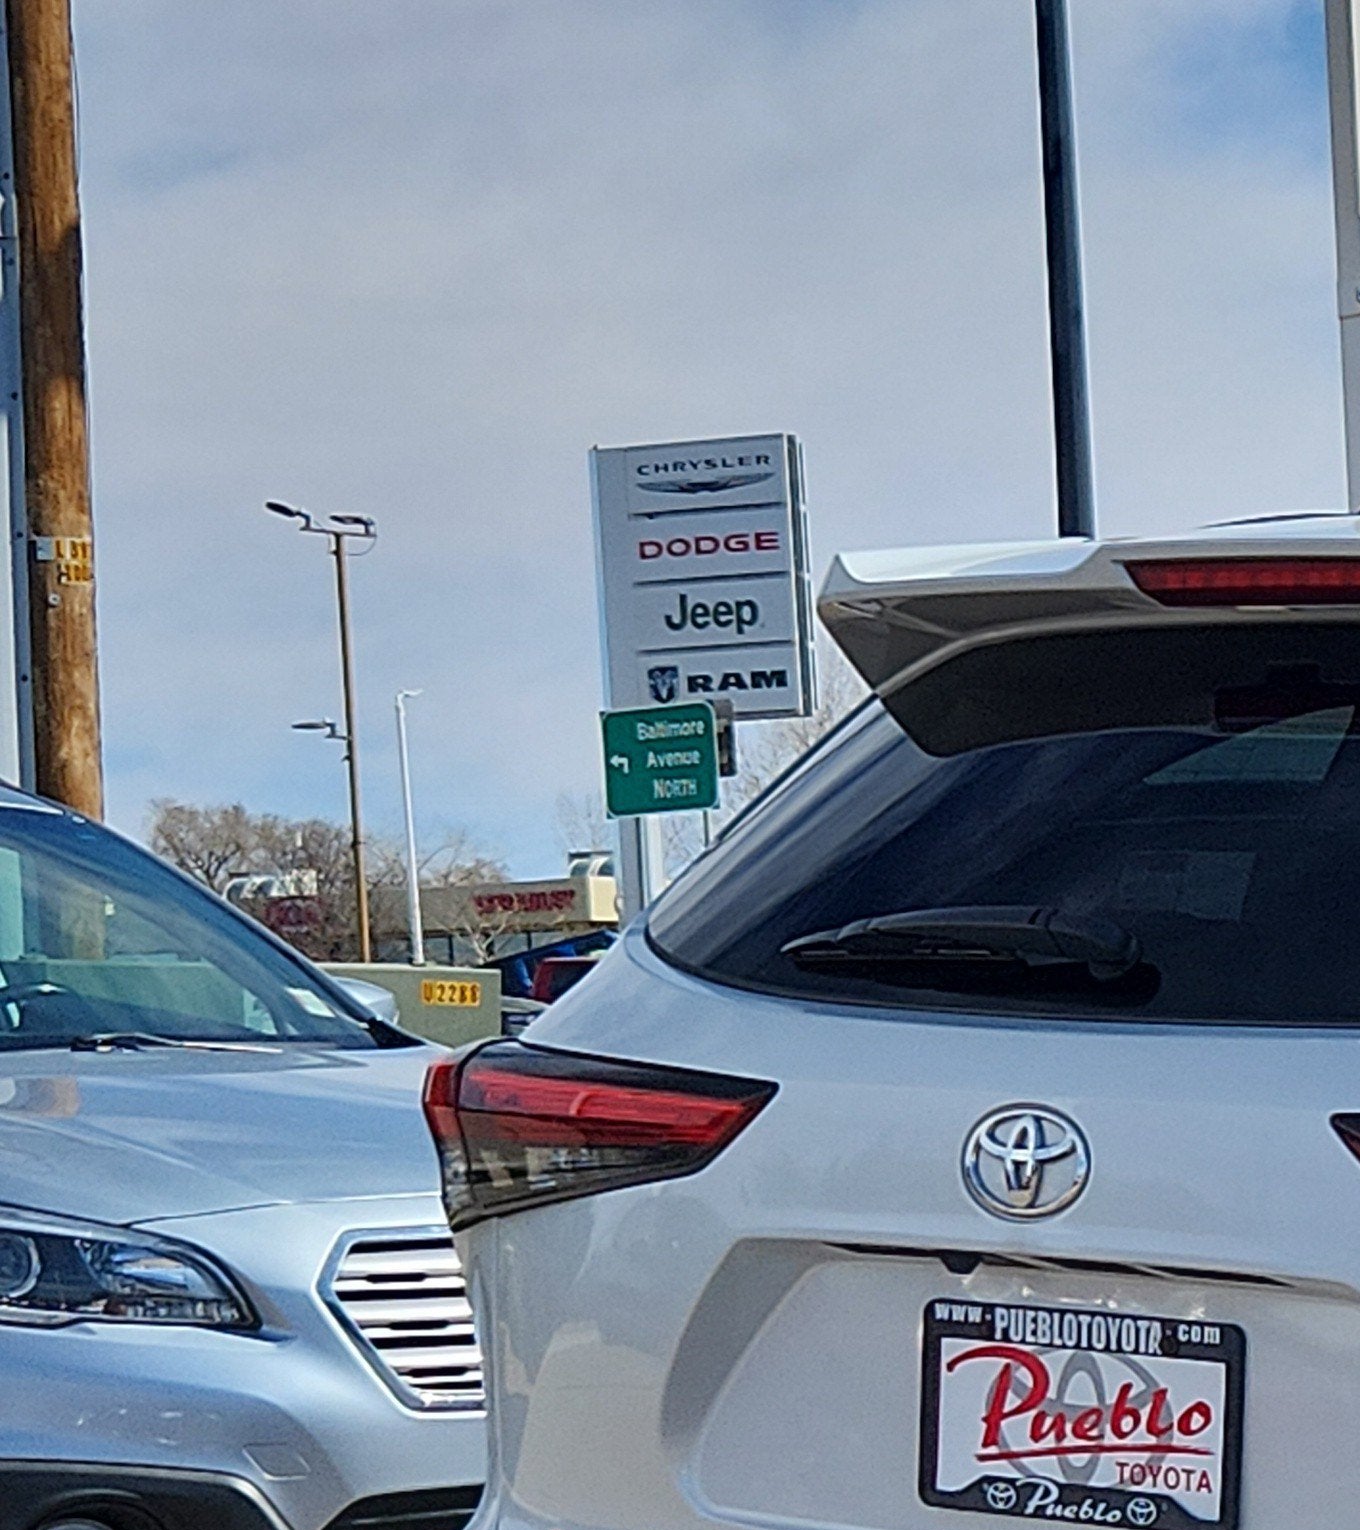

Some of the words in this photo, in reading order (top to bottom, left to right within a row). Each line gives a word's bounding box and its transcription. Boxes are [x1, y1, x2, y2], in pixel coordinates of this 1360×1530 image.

[637, 453, 771, 477] CHRYSLER
[638, 531, 780, 561] DODGE
[665, 593, 760, 634] Jeep
[686, 669, 788, 693] RAM
[636, 720, 705, 741] Baltimore
[646, 750, 701, 768] Avenue
[653, 778, 697, 799] NORTH
[946, 1345, 1213, 1448] Pueblo
[1116, 1461, 1213, 1493] TOYOTA
[1016, 1477, 1122, 1523] Pueblo
